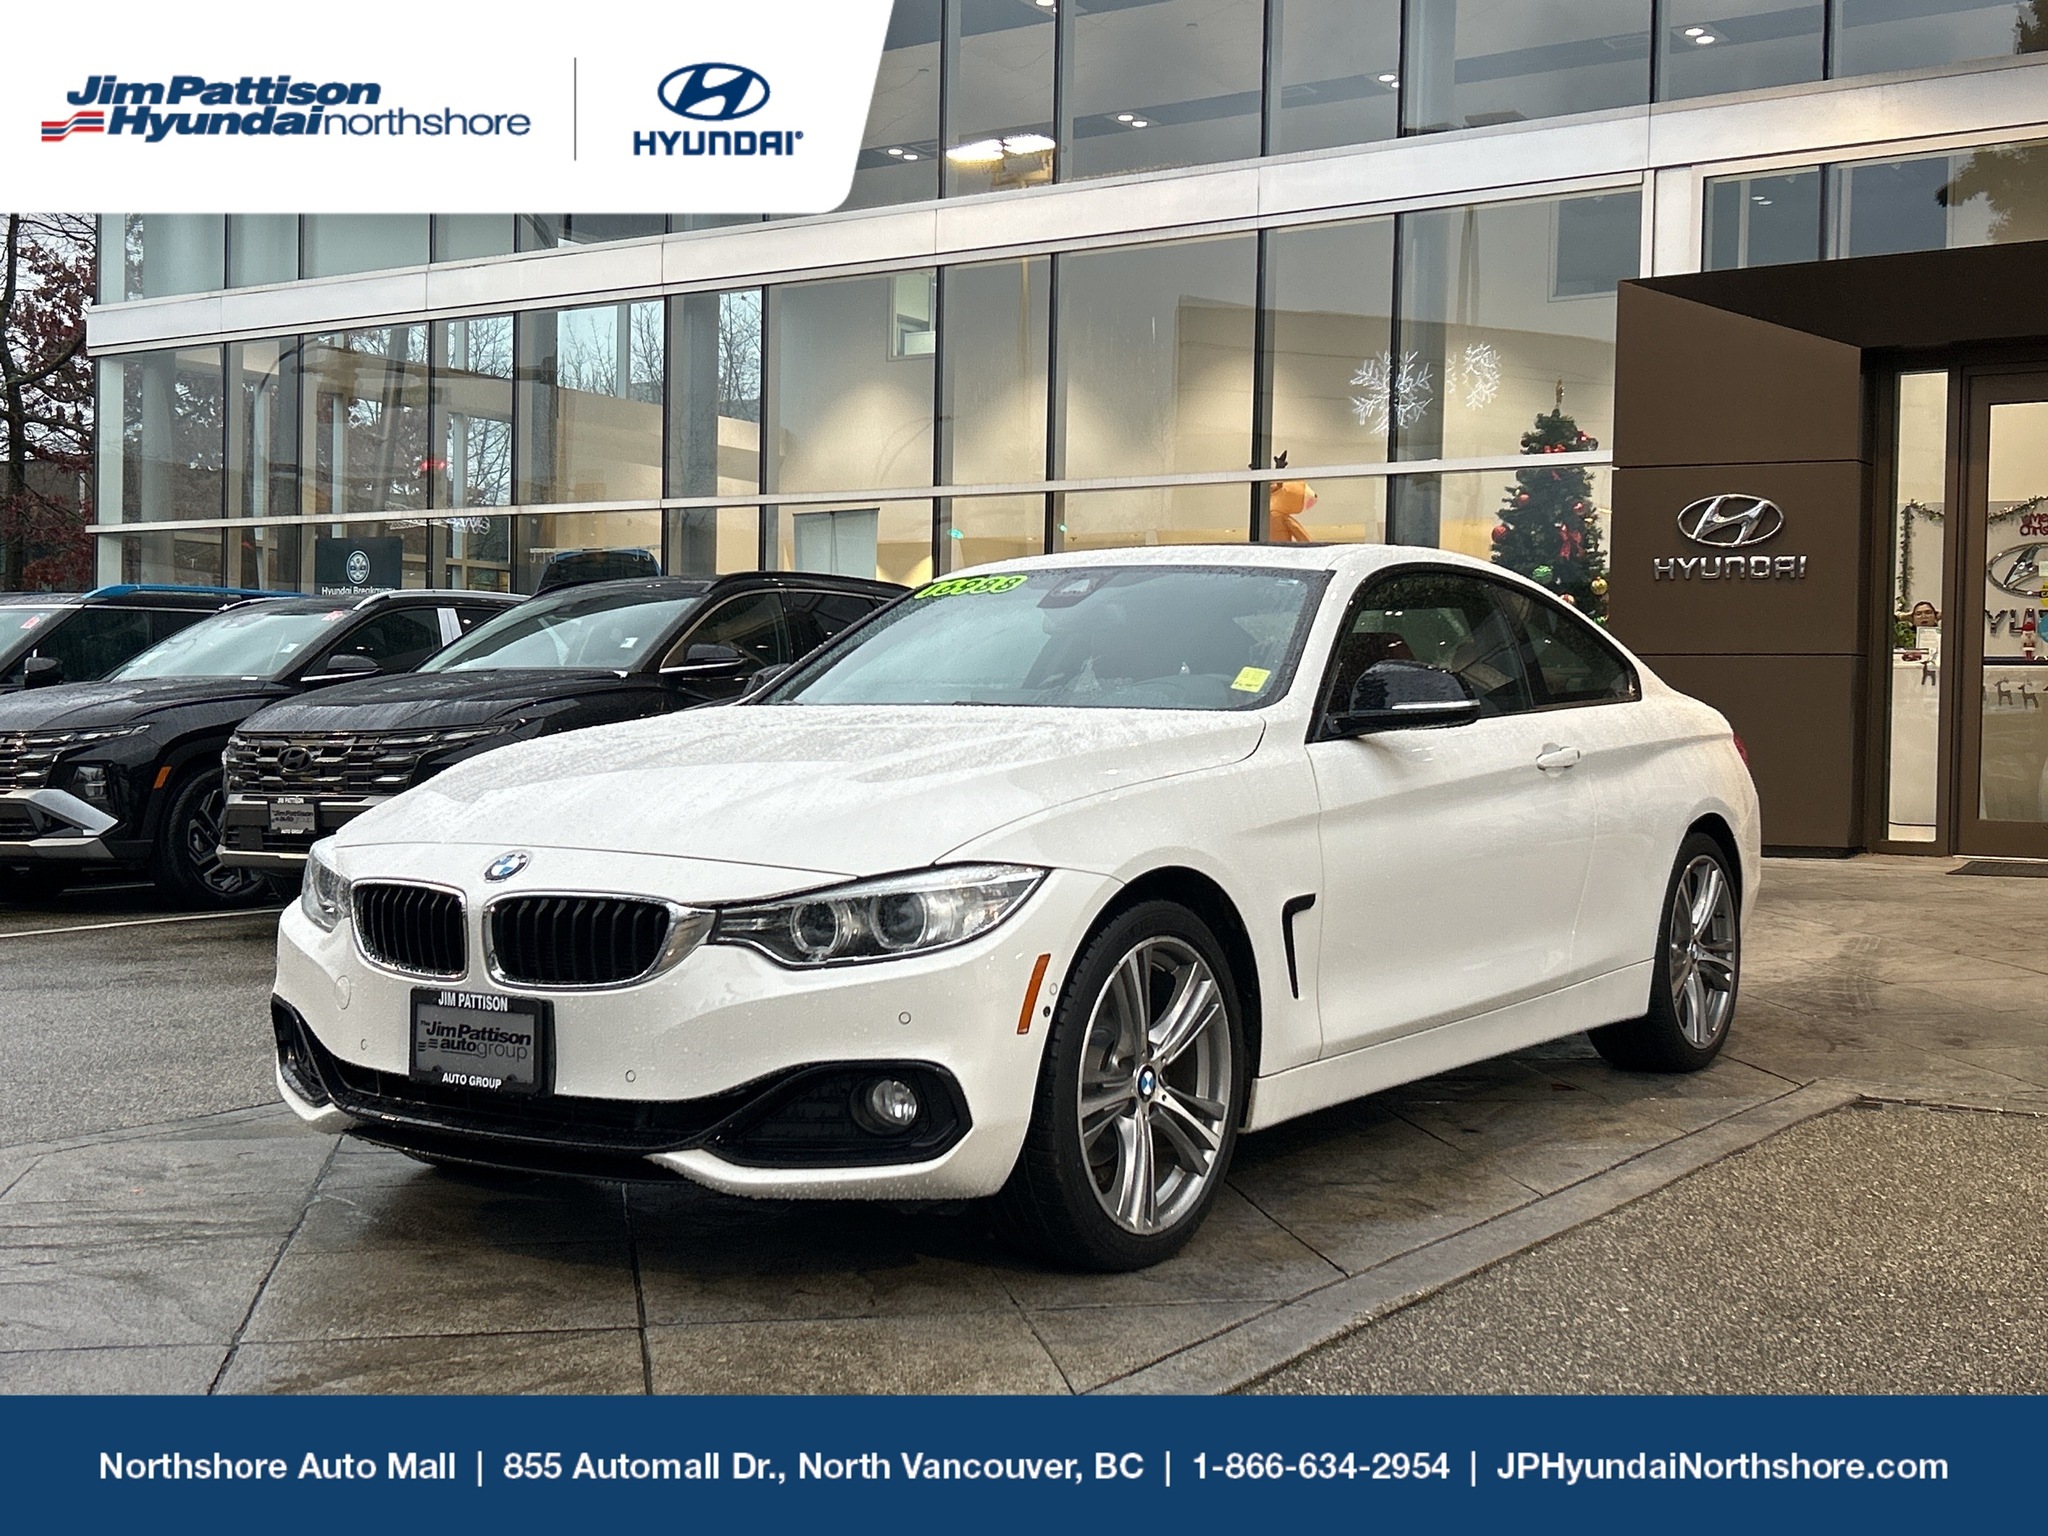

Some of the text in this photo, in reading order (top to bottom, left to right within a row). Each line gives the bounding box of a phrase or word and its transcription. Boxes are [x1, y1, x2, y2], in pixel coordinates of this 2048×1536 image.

[1653, 555, 1807, 581] HYUNDAI
[321, 586, 352, 596] Hyundai
[438, 991, 509, 1012] JIM PATTISON
[442, 1072, 502, 1090] AUTO GROUP
